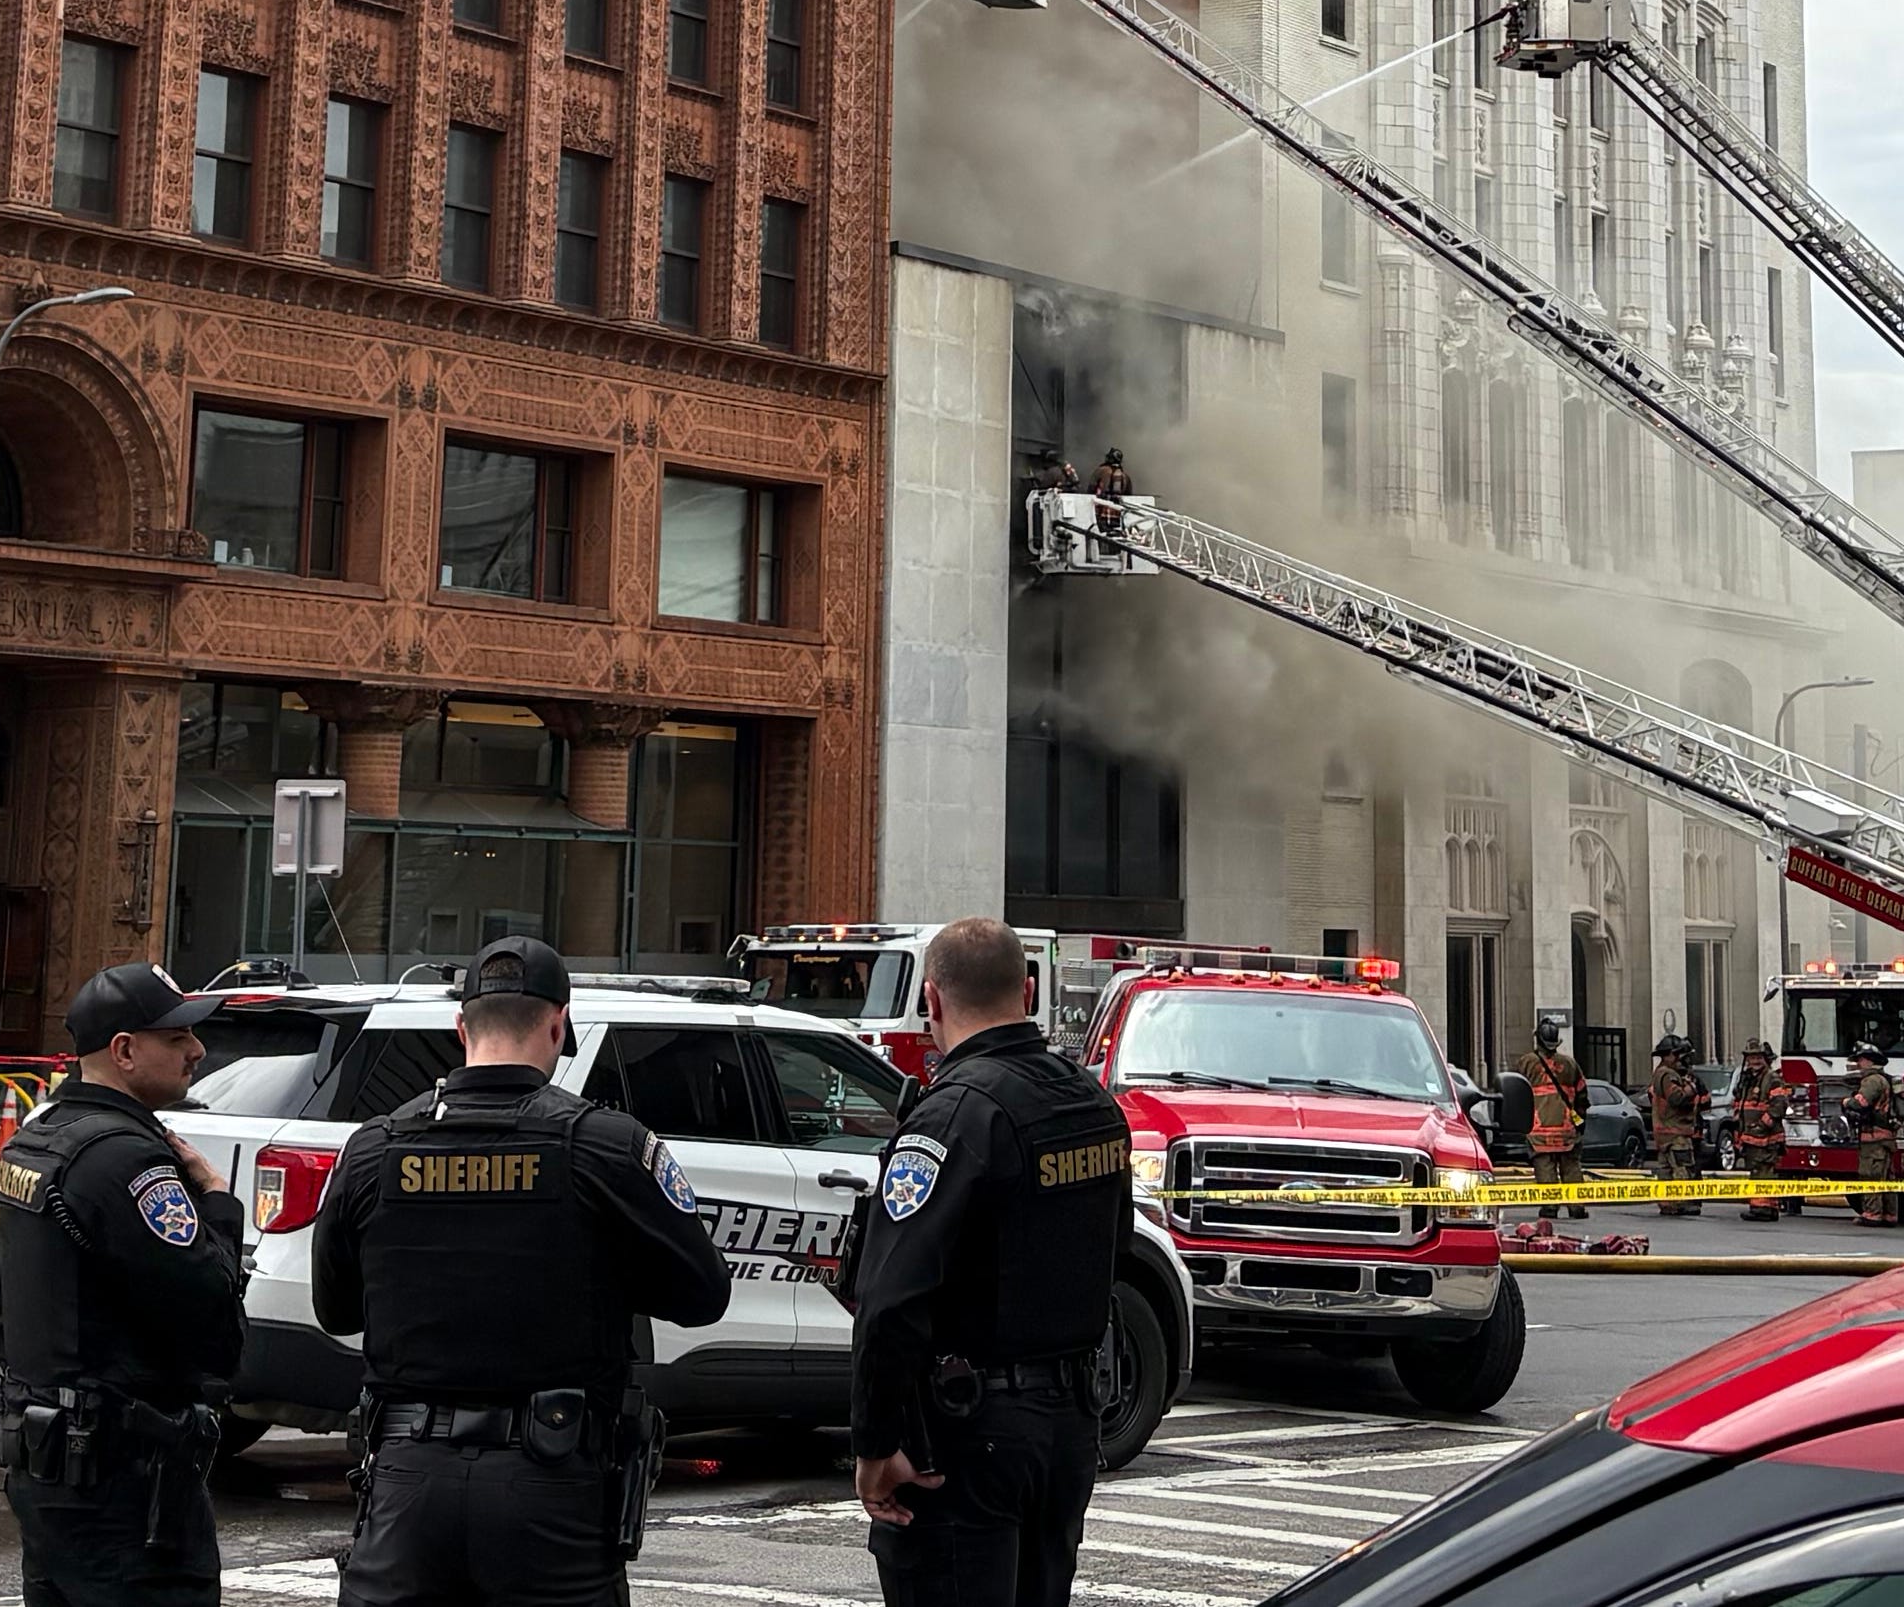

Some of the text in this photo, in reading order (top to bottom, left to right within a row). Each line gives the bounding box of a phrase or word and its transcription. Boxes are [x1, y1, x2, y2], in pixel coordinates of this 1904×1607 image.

[1791, 856, 1836, 888] BUFFALO
[1838, 878, 1863, 901] FIRE
[400, 1154, 541, 1193] SHERIFF
[1040, 1138, 1127, 1187] SHERIFF
